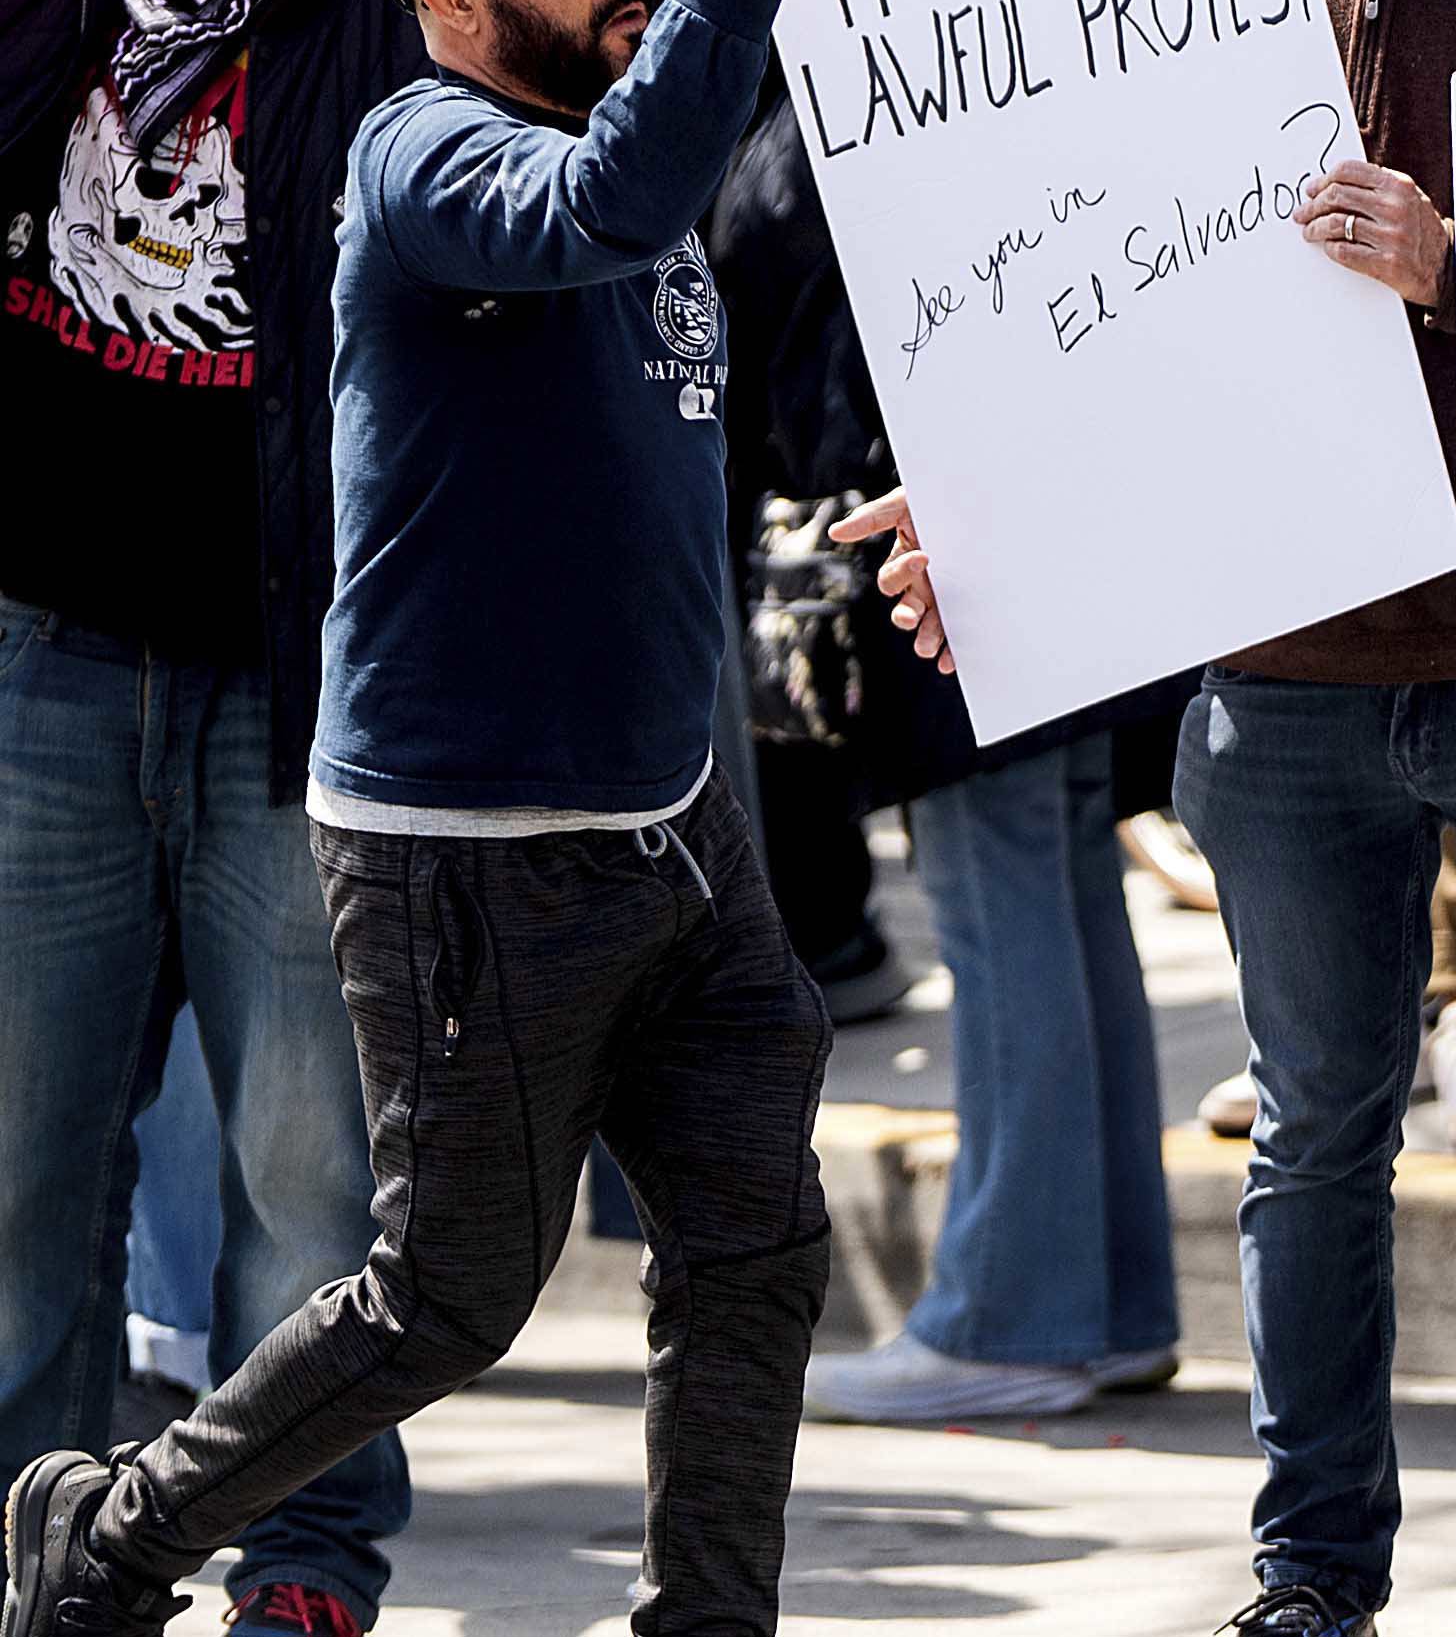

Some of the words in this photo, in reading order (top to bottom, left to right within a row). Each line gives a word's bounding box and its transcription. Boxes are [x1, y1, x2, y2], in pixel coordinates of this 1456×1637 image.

[971, 227, 1045, 314] you
[1047, 183, 1107, 224] in
[1045, 272, 1118, 355] El
[102, 333, 174, 381] DIE
